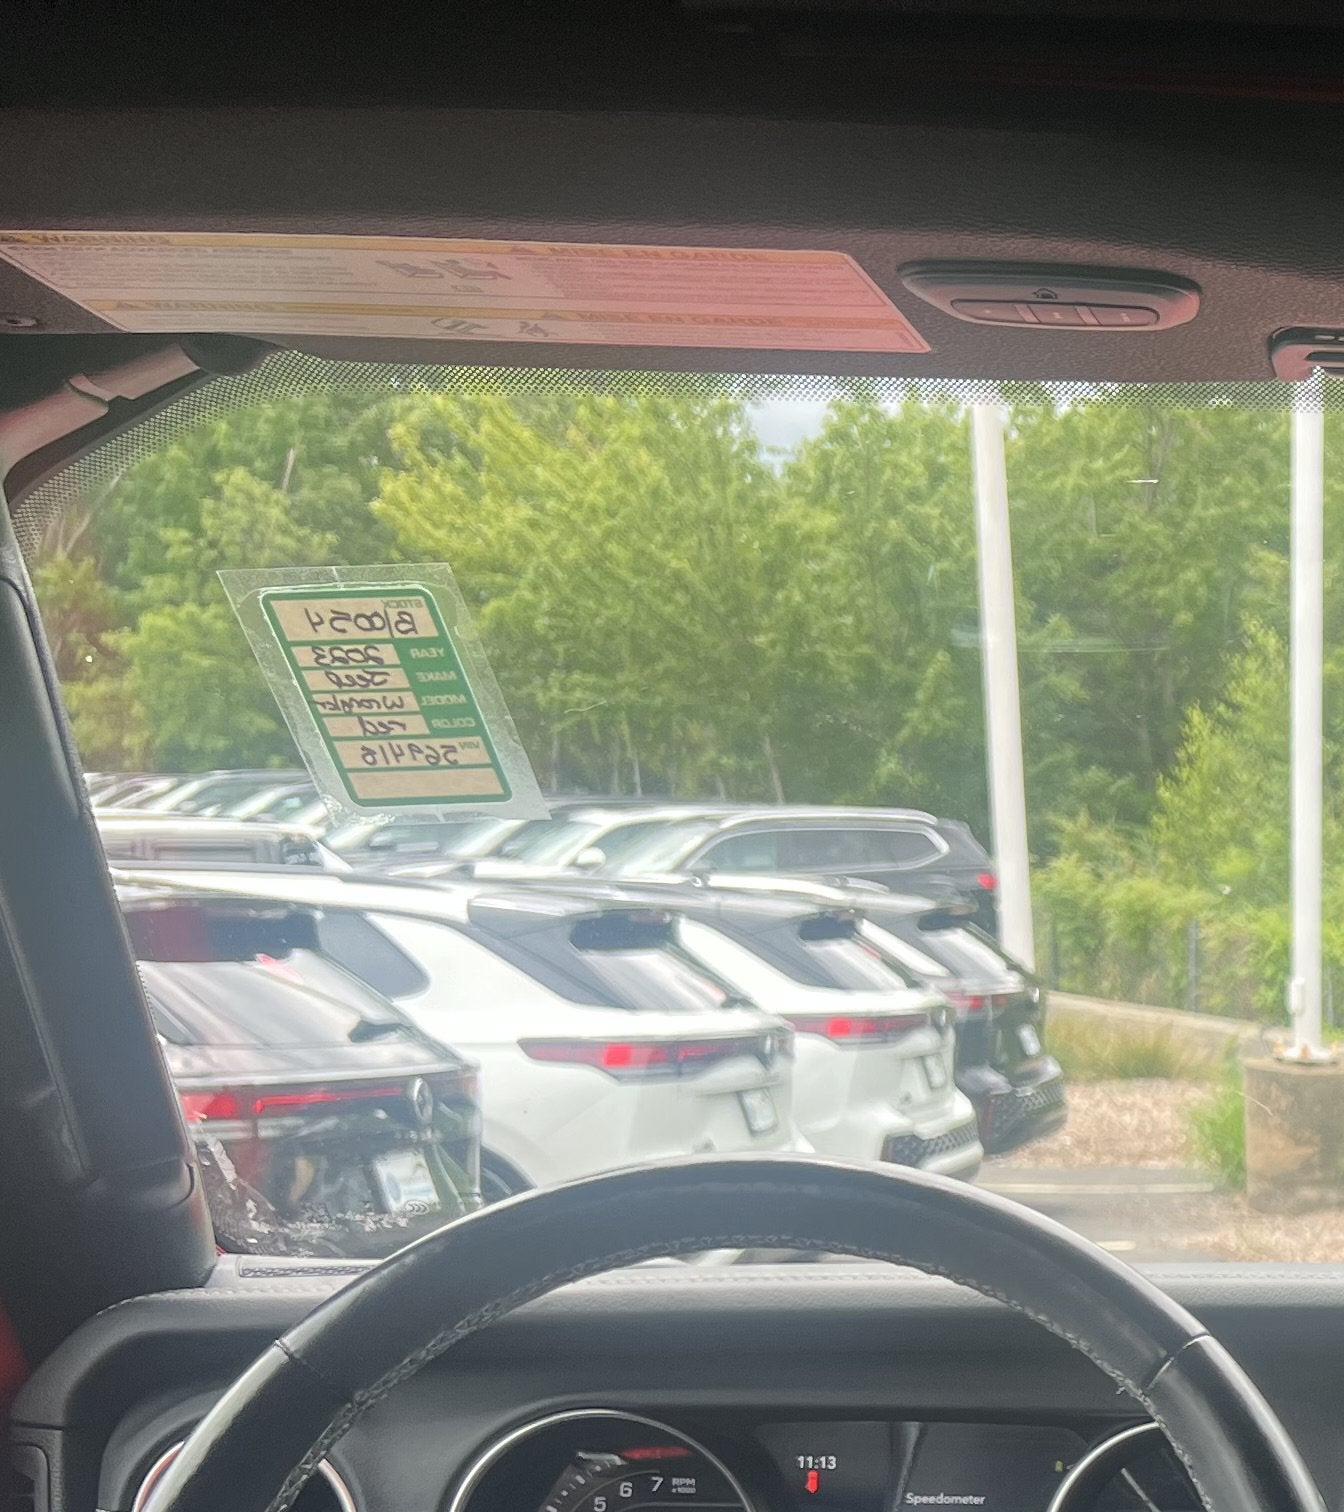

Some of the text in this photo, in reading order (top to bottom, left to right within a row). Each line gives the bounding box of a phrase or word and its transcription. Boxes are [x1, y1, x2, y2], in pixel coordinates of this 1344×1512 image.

[797, 1455, 837, 1470] 11:13
[619, 1482, 633, 1498] 6
[651, 1477, 664, 1492] 7
[672, 1478, 696, 1487] RPM
[593, 1496, 607, 1512] 5
[905, 1492, 986, 1506] Speedometer
